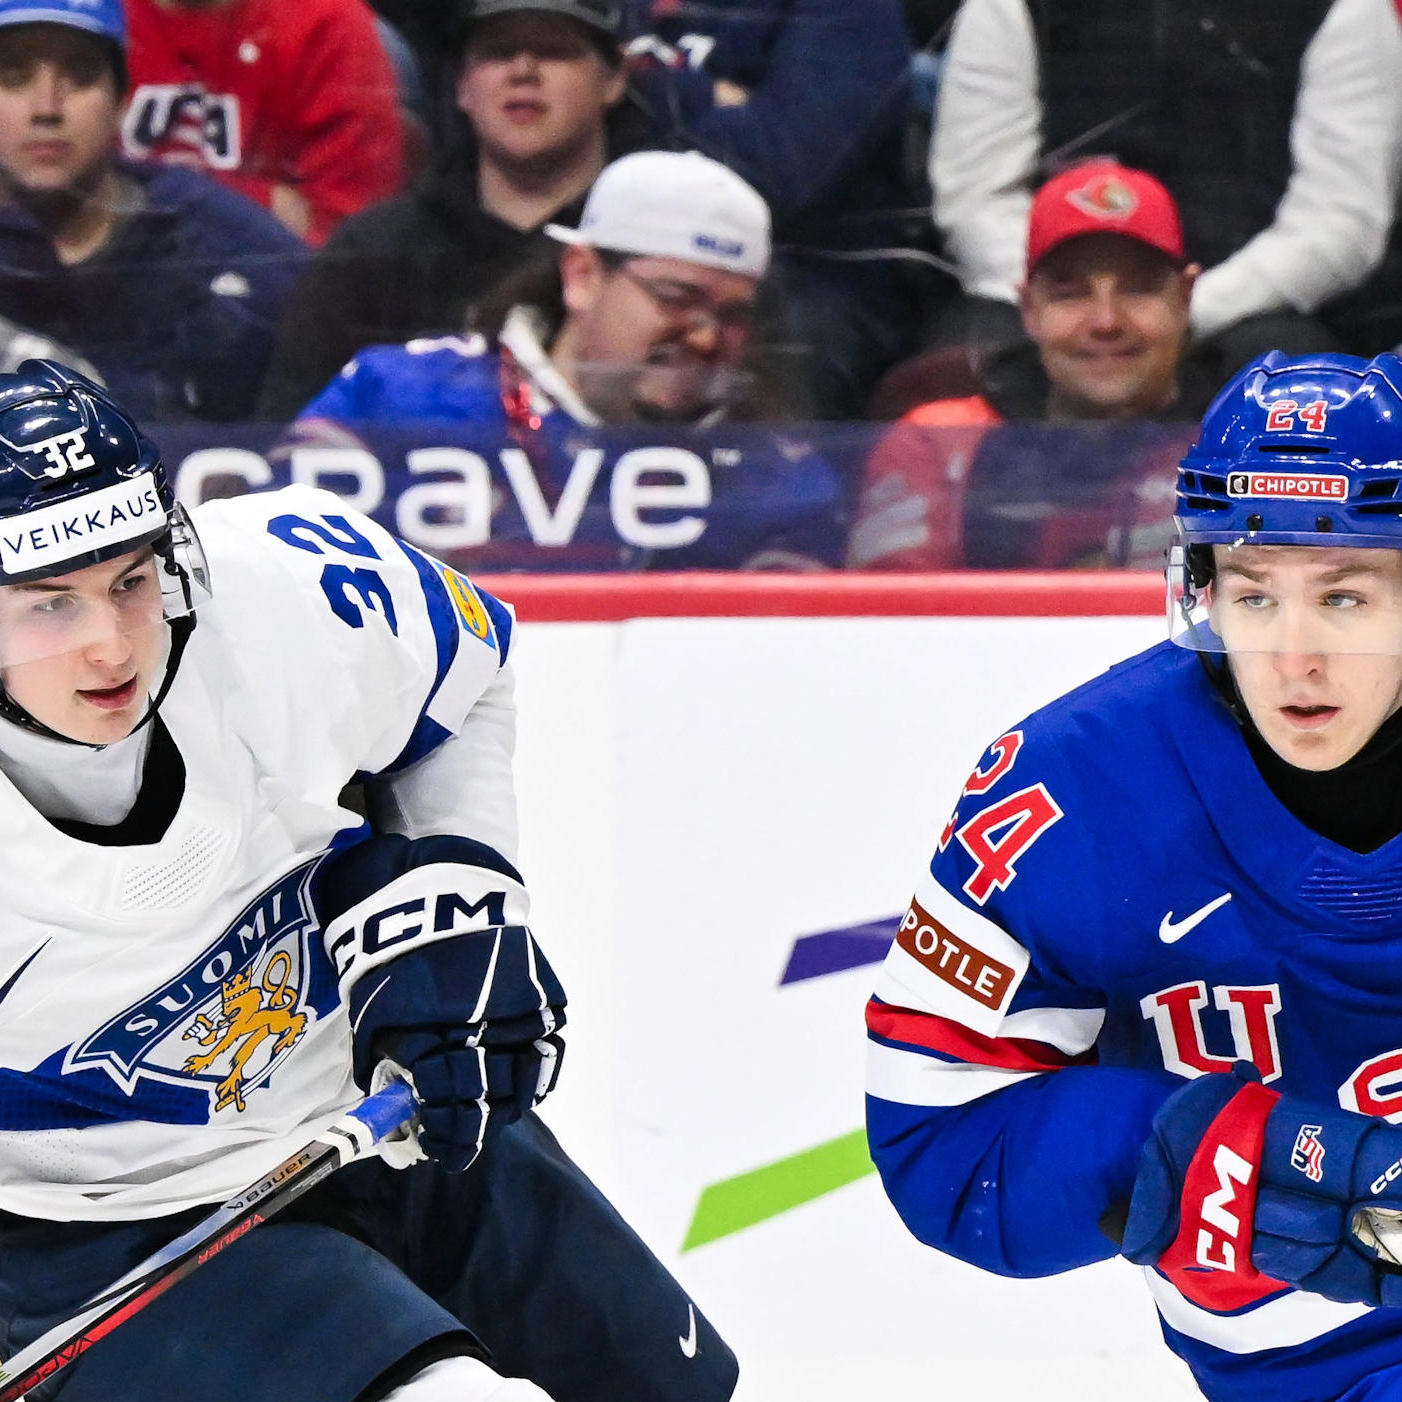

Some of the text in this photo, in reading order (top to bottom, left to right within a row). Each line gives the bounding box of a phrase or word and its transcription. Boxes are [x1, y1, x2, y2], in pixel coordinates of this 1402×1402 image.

[1265, 399, 1329, 433] 24
[31, 433, 96, 480] 32
[1253, 478, 1344, 496] CHIPOTLE
[3, 490, 158, 555] VEIKKAUS
[124, 888, 285, 1039] SUOMI
[1290, 1123, 1326, 1184] USA
